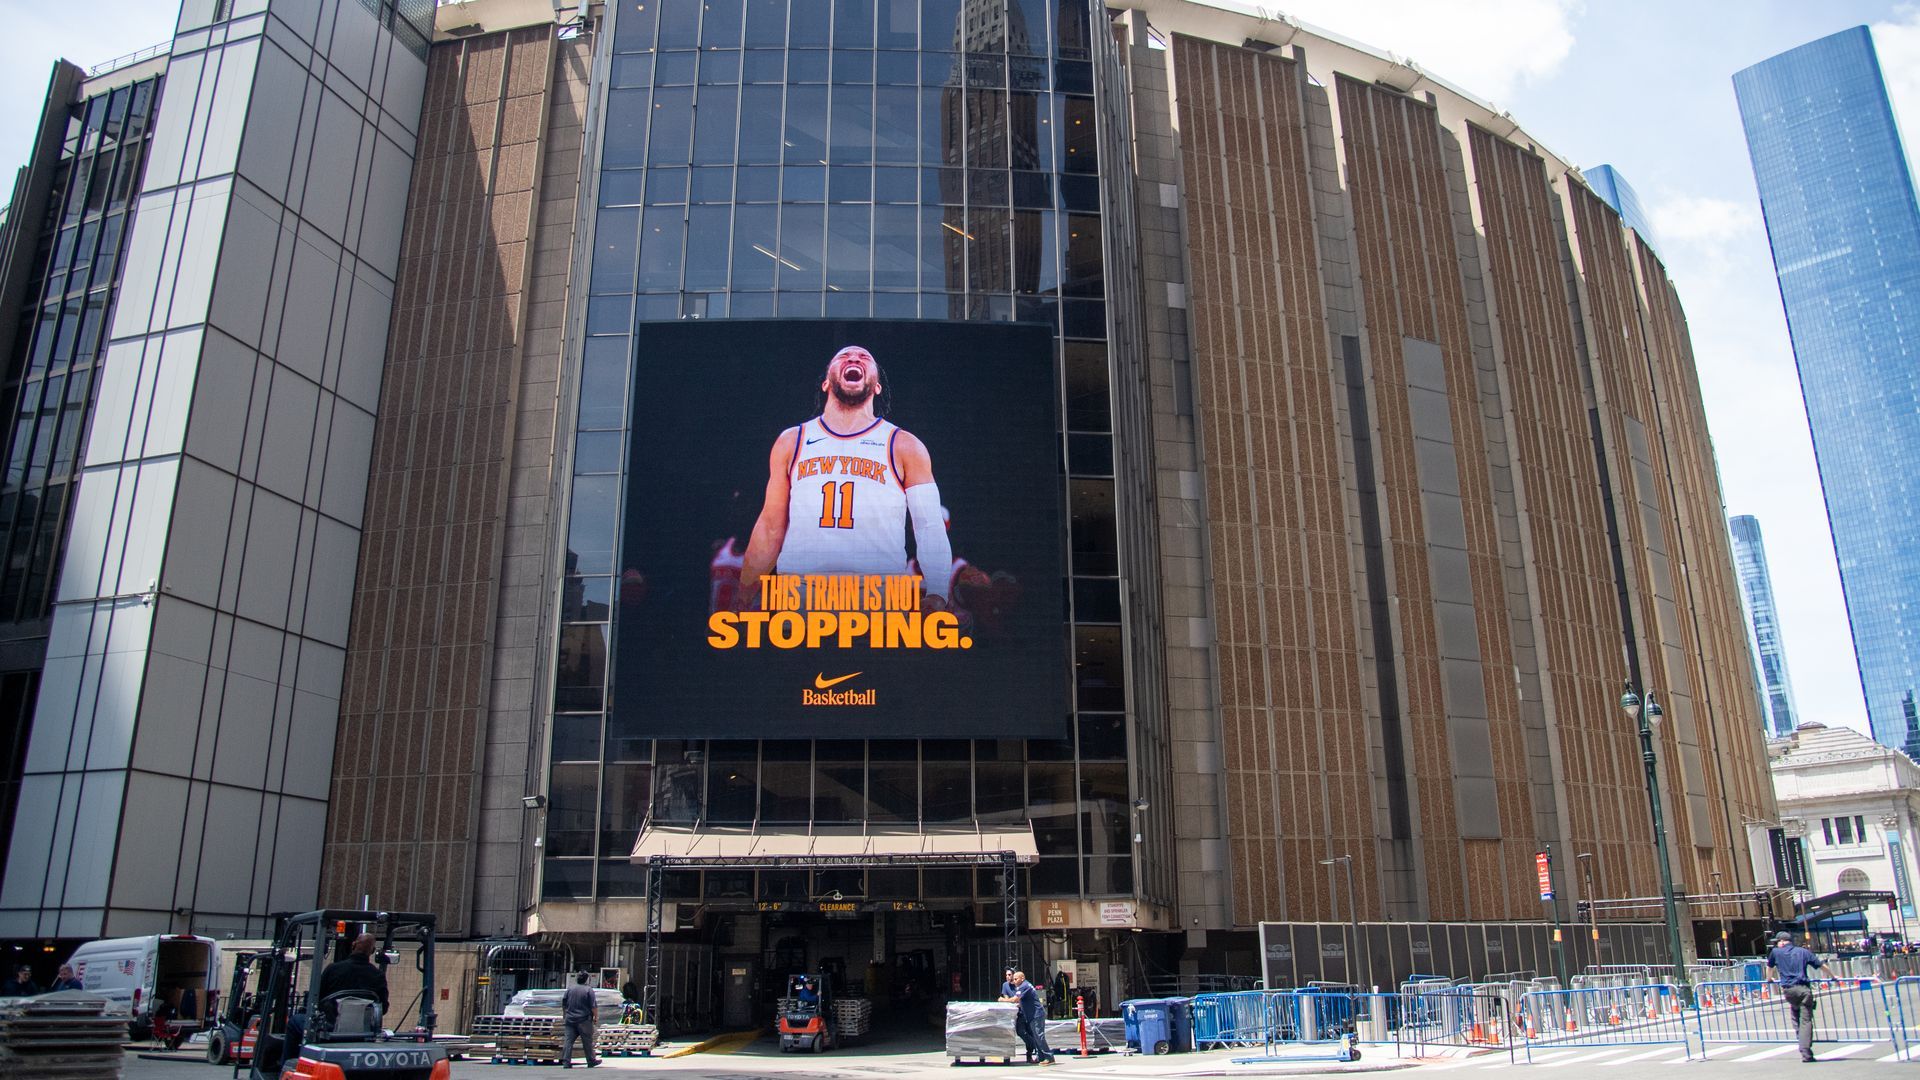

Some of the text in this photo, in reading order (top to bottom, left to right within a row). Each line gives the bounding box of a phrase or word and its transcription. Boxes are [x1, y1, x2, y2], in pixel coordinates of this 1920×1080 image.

[797, 456, 887, 485] NEW YORK
[819, 481, 854, 529] 11
[759, 575, 923, 611] THIS TRAIN IS NOT
[707, 611, 973, 649] STOPPING.
[802, 689, 876, 706] Basketball
[819, 903, 856, 911] CLEARANCE
[1047, 916, 1064, 924] PLAZA
[350, 1051, 431, 1067] TOYOTA
